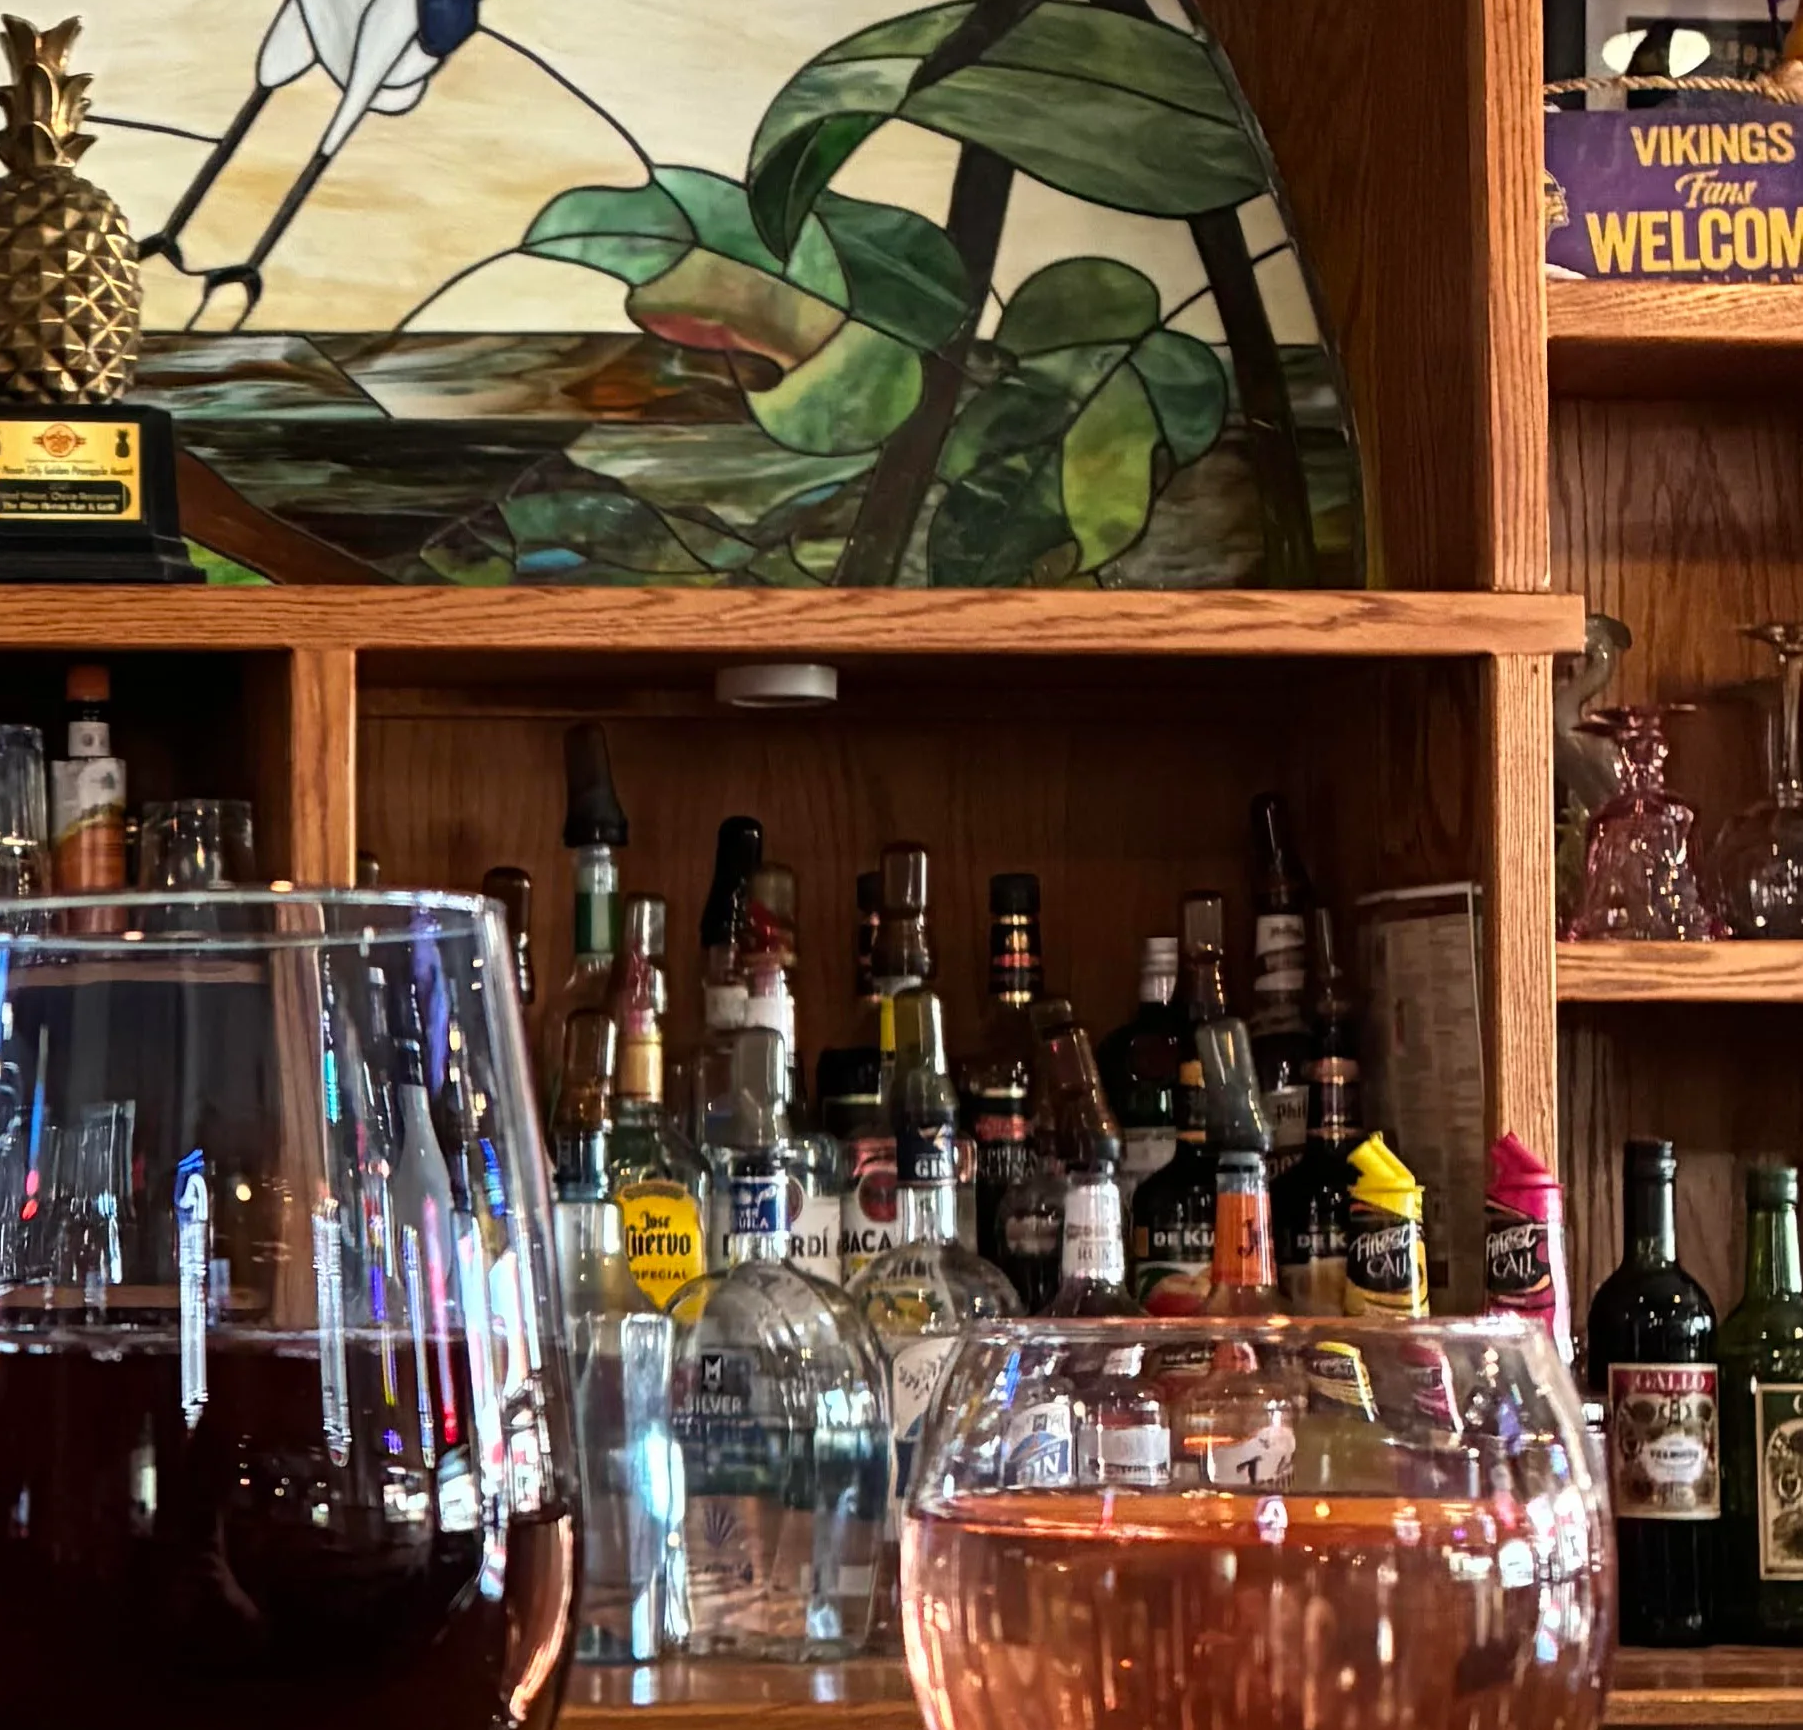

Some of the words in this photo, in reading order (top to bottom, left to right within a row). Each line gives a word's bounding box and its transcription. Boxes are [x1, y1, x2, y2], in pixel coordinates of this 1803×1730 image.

[1630, 121, 1795, 166] VIKINGS
[1674, 170, 1757, 208] Fans
[639, 1210, 671, 1231] Jose
[626, 1224, 691, 1261] Cuervo
[634, 1271, 687, 1281] SPECIAL
